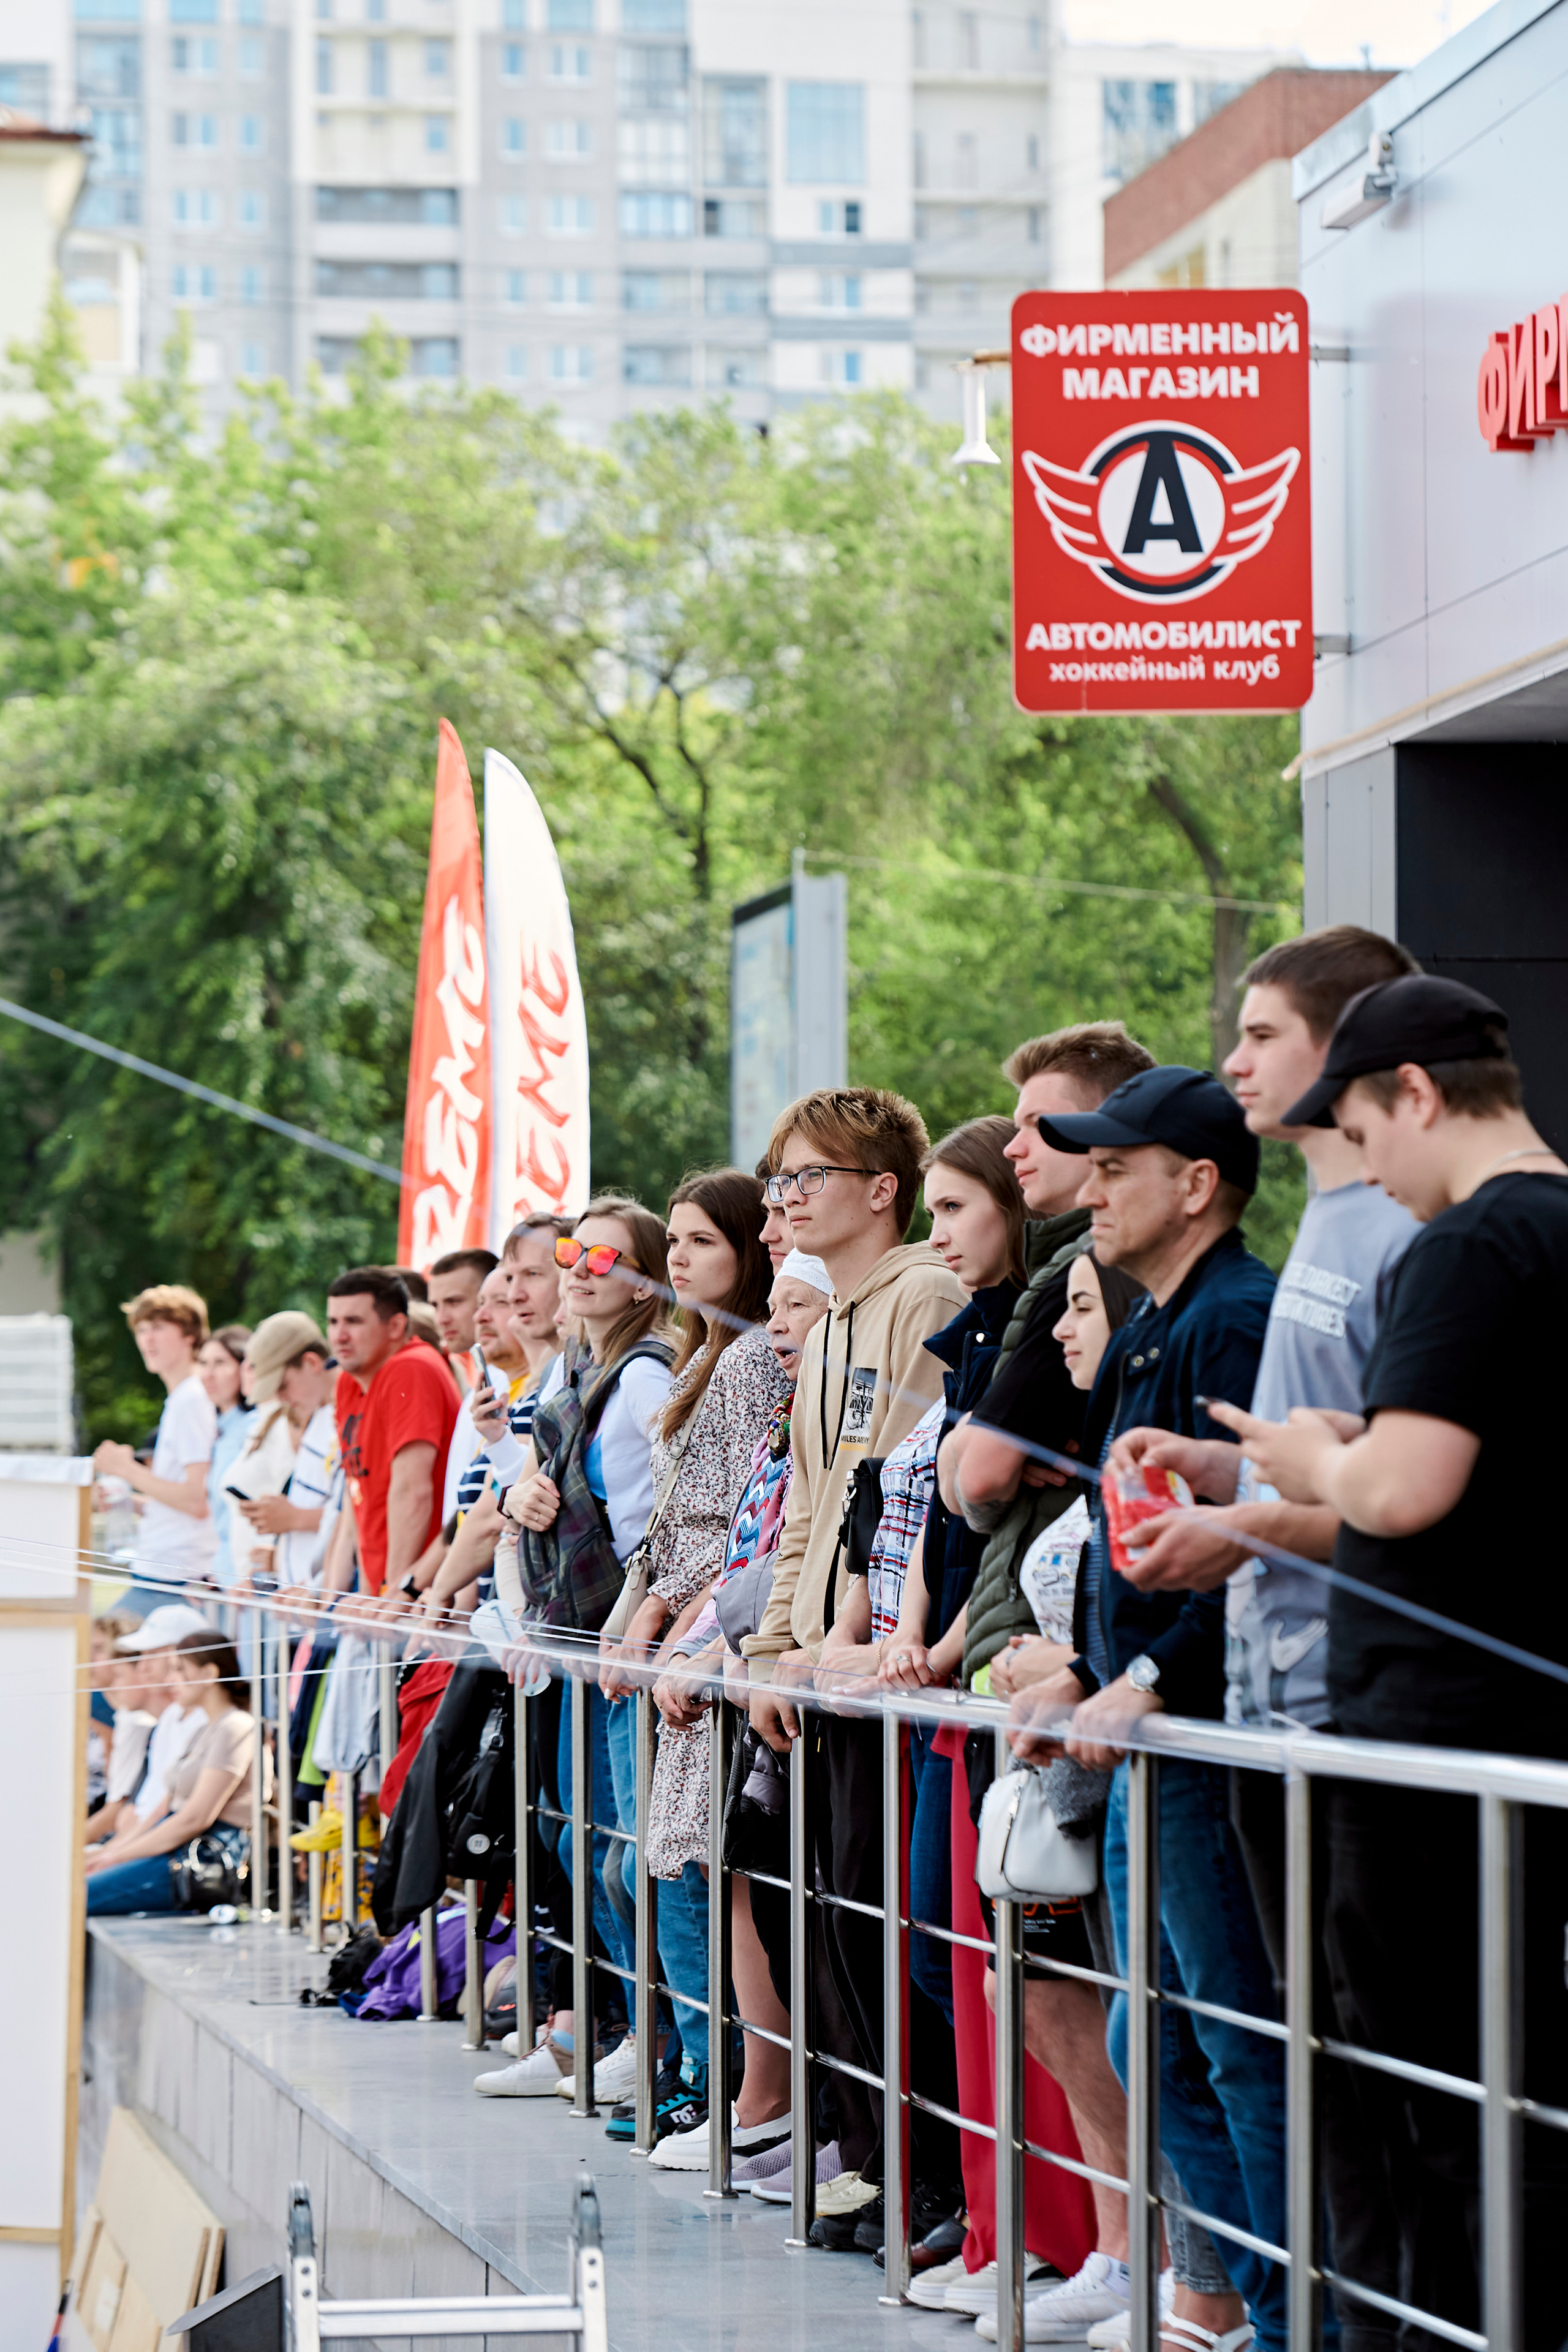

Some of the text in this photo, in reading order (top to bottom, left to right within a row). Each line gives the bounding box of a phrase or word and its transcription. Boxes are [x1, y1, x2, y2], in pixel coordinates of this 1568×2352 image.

[1020, 311, 1300, 356] ФИРМЕННЫЙ
[1062, 366, 1260, 400] МАГАЗИН
[1025, 620, 1302, 651] АВТОМОБИЛИСТ
[1049, 654, 1280, 685] хоккейный клуб
